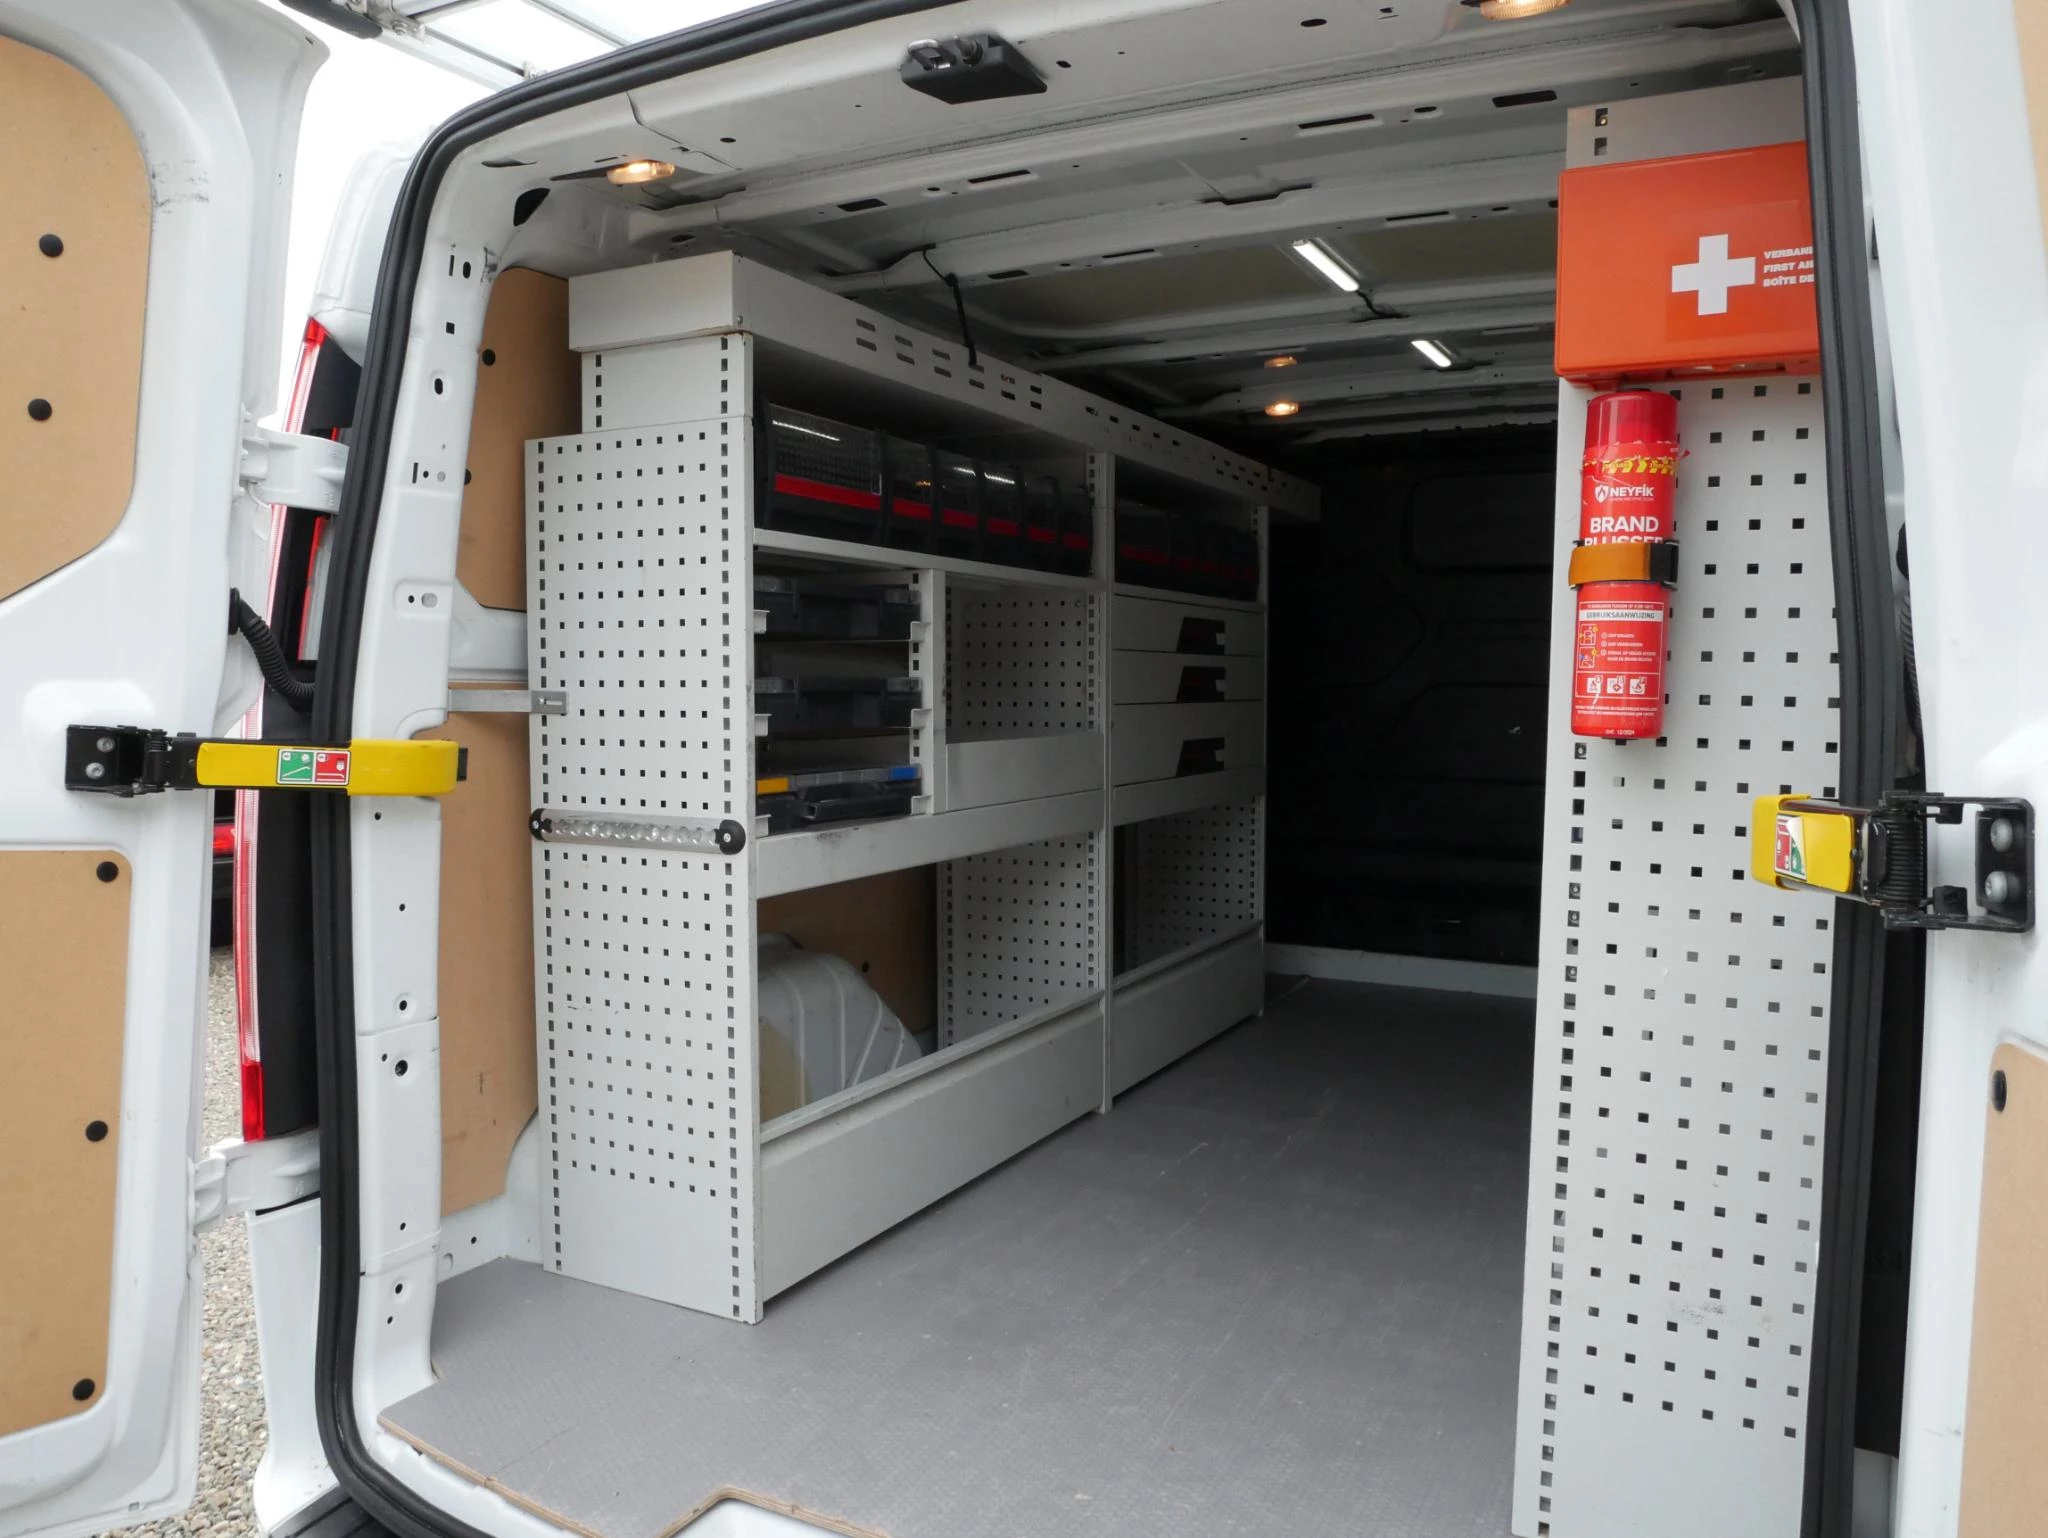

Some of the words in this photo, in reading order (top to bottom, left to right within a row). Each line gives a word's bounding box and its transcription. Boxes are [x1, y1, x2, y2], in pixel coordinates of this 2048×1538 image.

[1763, 262, 1795, 273] FIRST
[1763, 275, 1796, 287] BOÎTE
[1590, 515, 1659, 534] BRAND
